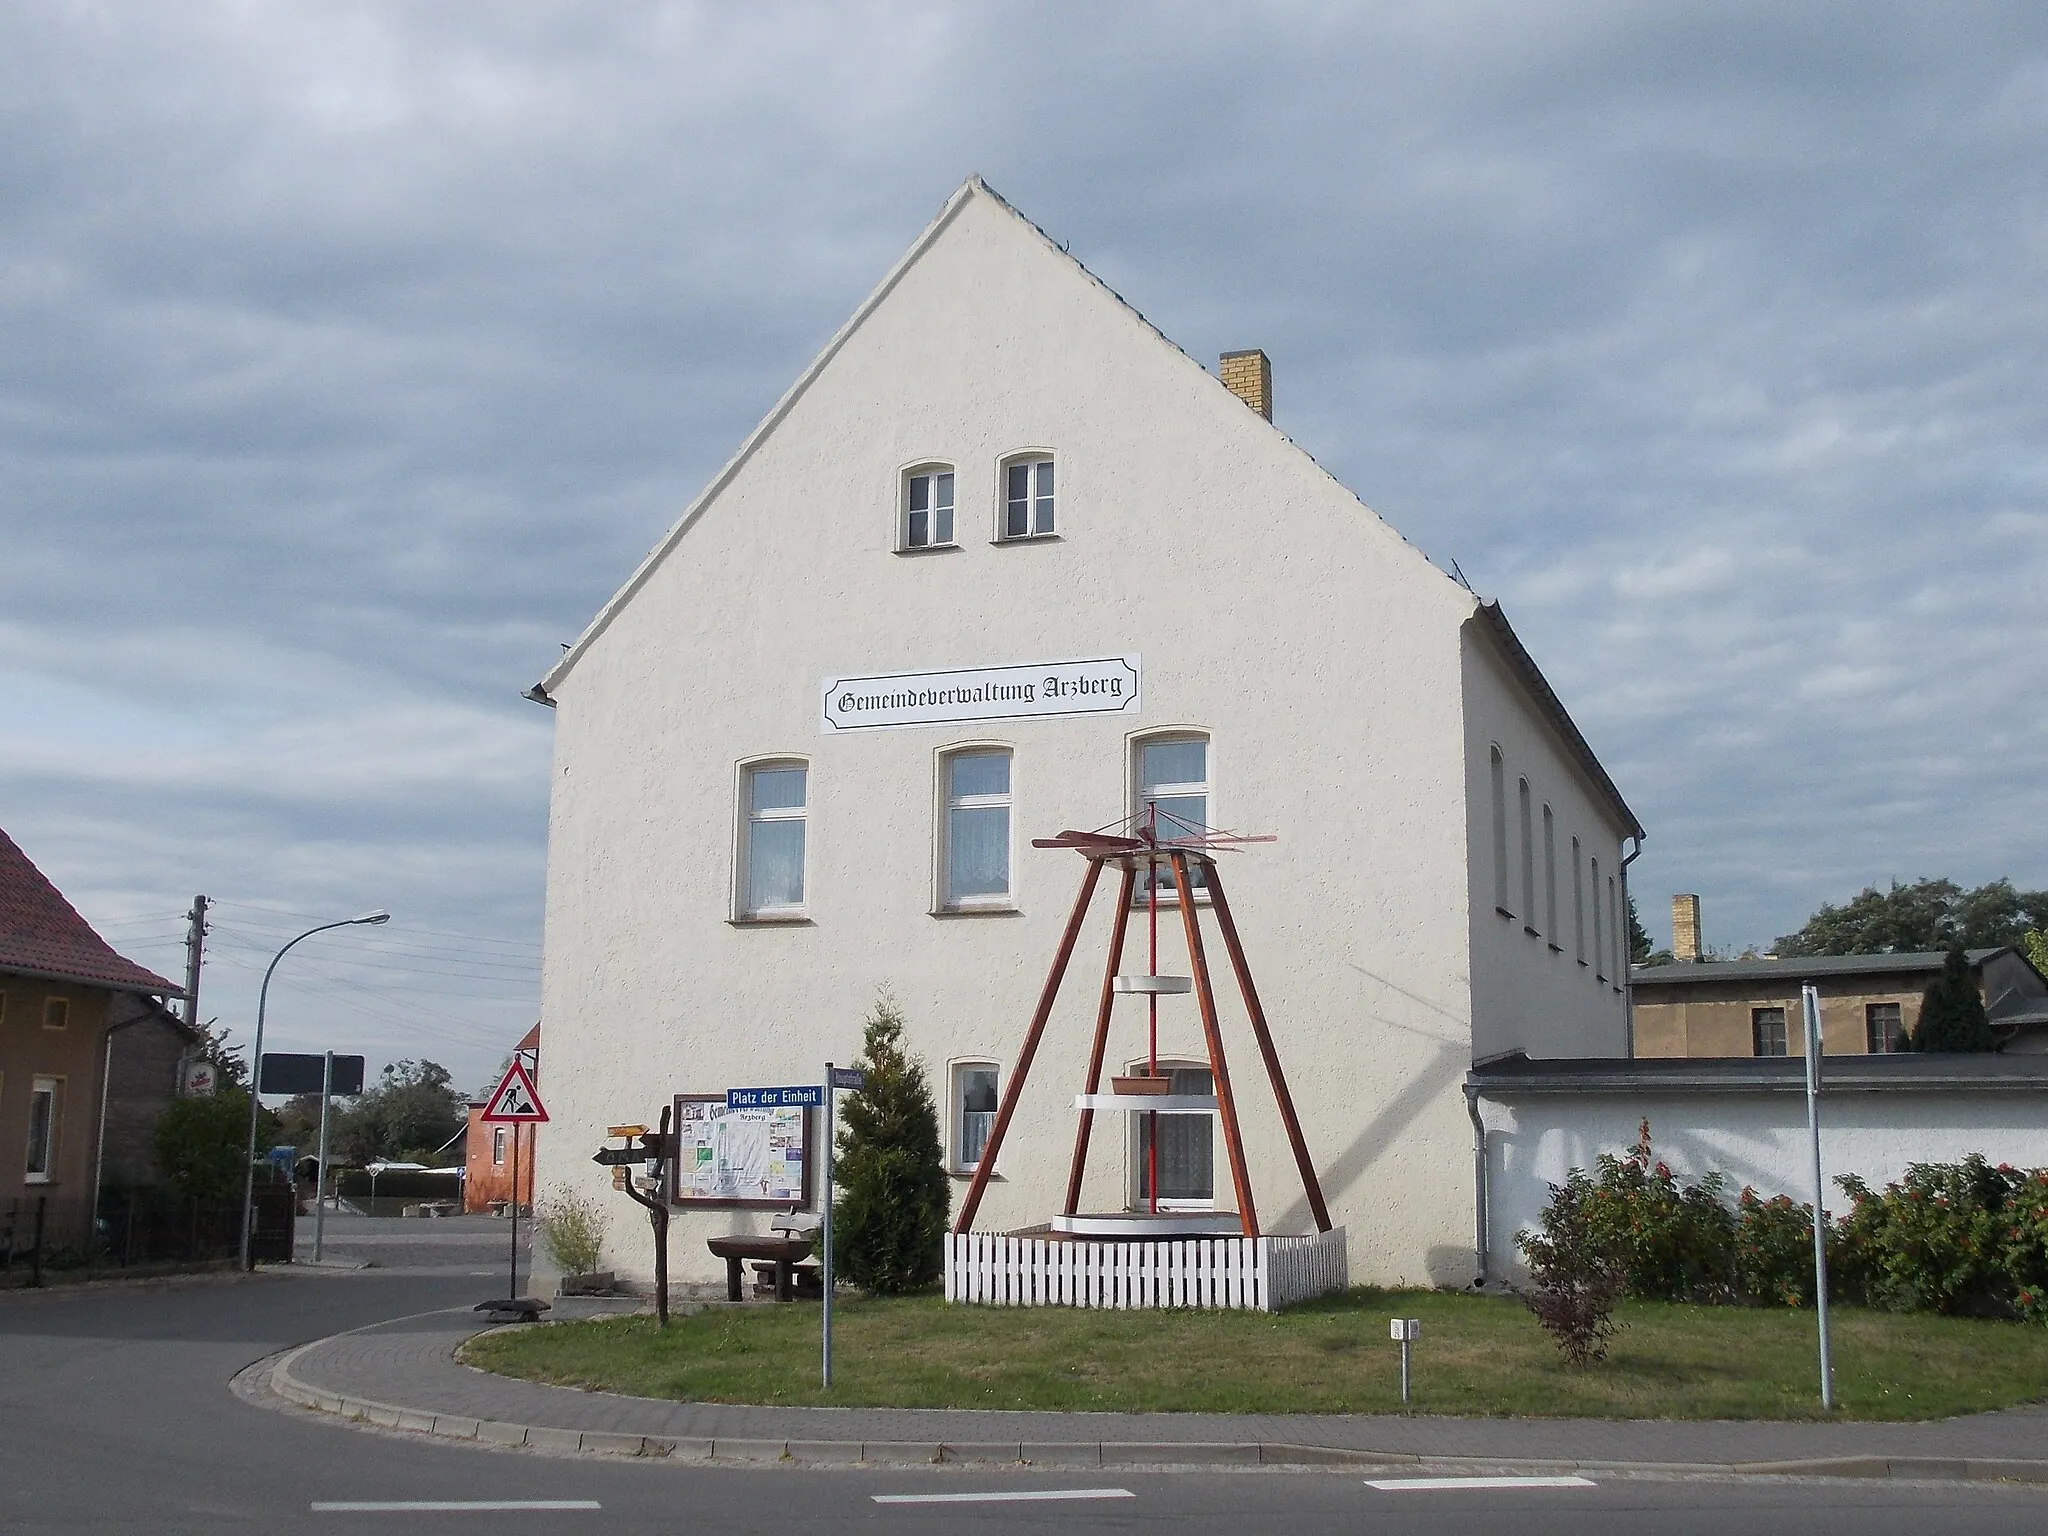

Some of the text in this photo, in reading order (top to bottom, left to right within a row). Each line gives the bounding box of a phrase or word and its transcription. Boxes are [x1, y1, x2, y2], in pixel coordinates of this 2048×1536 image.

[838, 675, 1123, 713] Gemeindeverwaltung Arzberg
[733, 1090, 816, 1104] Platz der Einheit
